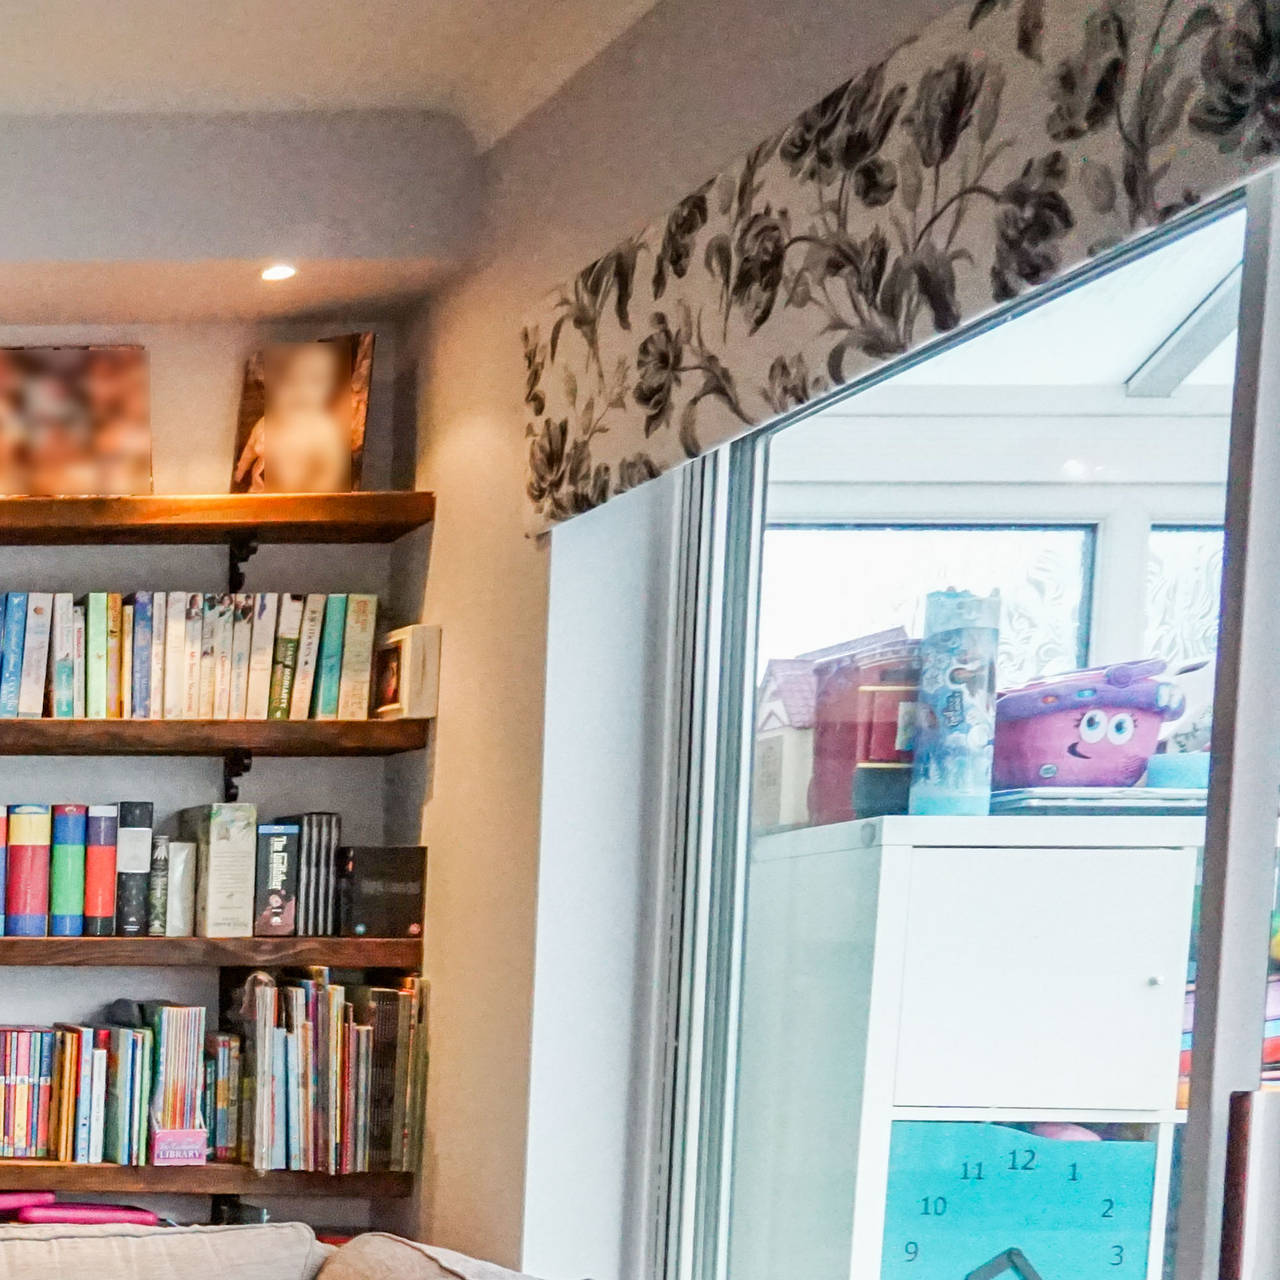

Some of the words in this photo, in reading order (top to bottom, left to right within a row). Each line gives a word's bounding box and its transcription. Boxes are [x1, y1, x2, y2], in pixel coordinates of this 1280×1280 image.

[277, 667, 293, 708] MORIARTY
[268, 852, 288, 890] Godfather
[159, 1149, 201, 1159] LIBRARY
[1007, 1148, 1037, 1172] 12
[959, 1161, 985, 1182] 11
[1067, 1162, 1079, 1182] 1
[920, 1196, 948, 1216] 10
[1100, 1197, 1115, 1219] 2
[904, 1241, 919, 1263] 9
[1109, 1244, 1124, 1266] 3
